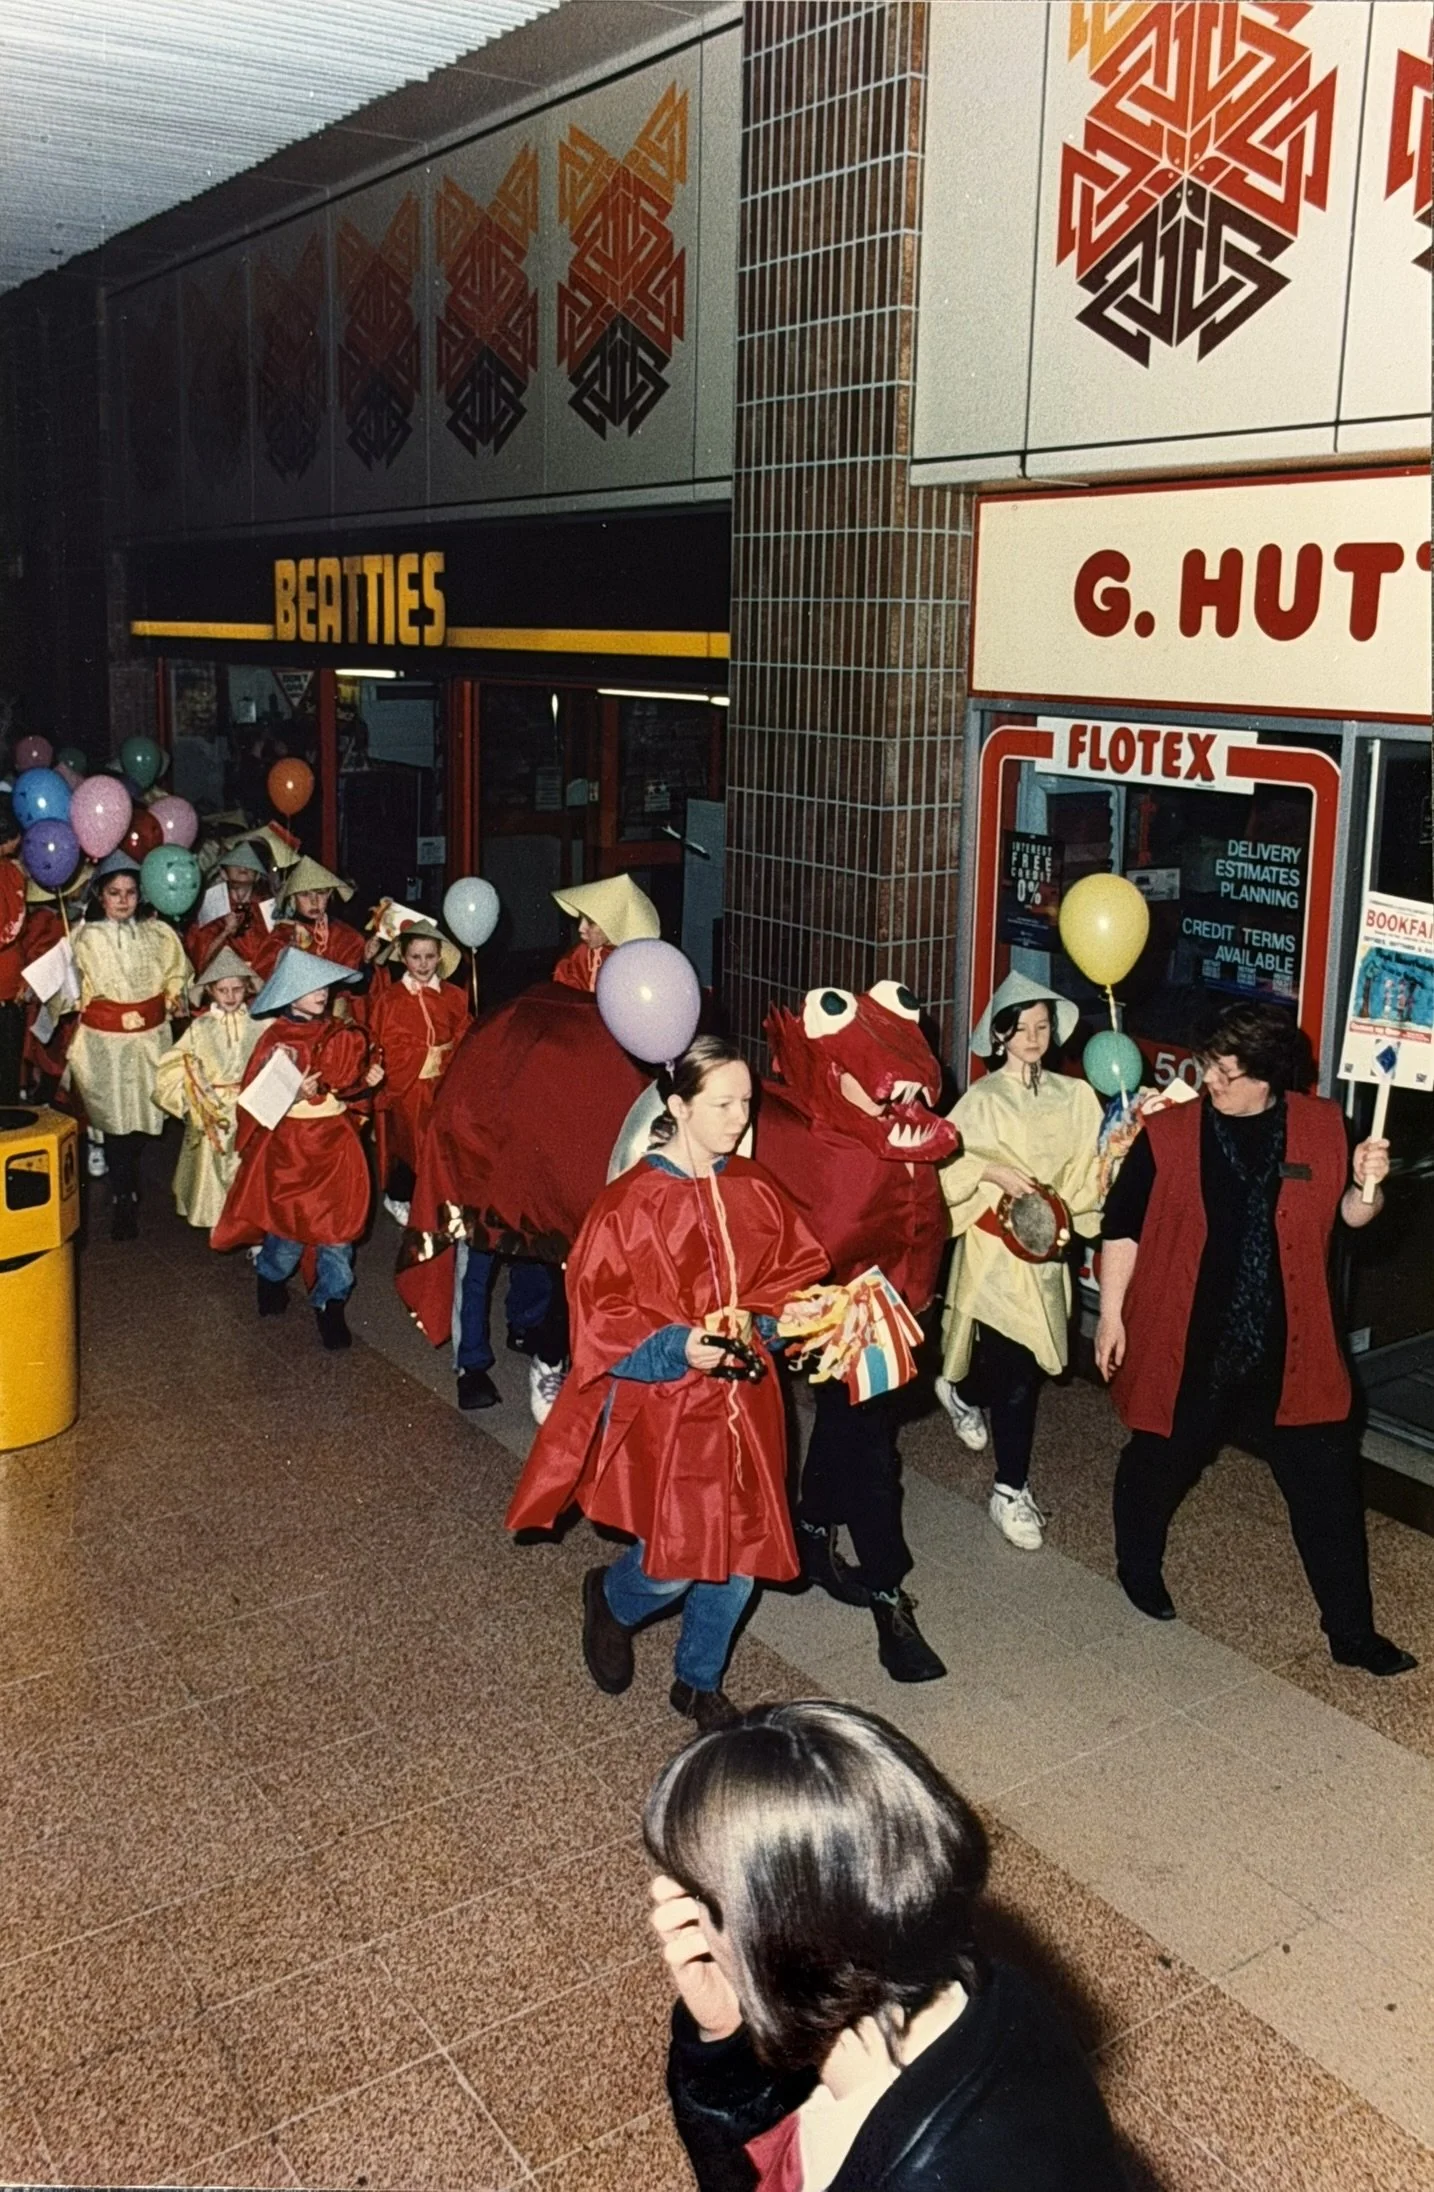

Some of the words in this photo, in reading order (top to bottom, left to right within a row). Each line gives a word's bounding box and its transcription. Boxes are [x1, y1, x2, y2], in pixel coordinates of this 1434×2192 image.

[275, 552, 446, 646] BEATTIES
[1074, 549, 1155, 638] G.
[1068, 724, 1217, 782] FLOTEX
[1011, 851, 1052, 873] FREE
[1228, 839, 1301, 864] DELIVERY
[1215, 859, 1300, 887] ESTIMATES
[1017, 879, 1042, 905] 0%
[1220, 881, 1299, 909] PLANNING
[1182, 917, 1236, 941] CREDIT
[1242, 927, 1296, 953] TERMS
[1215, 945, 1294, 975] AVAILABLE
